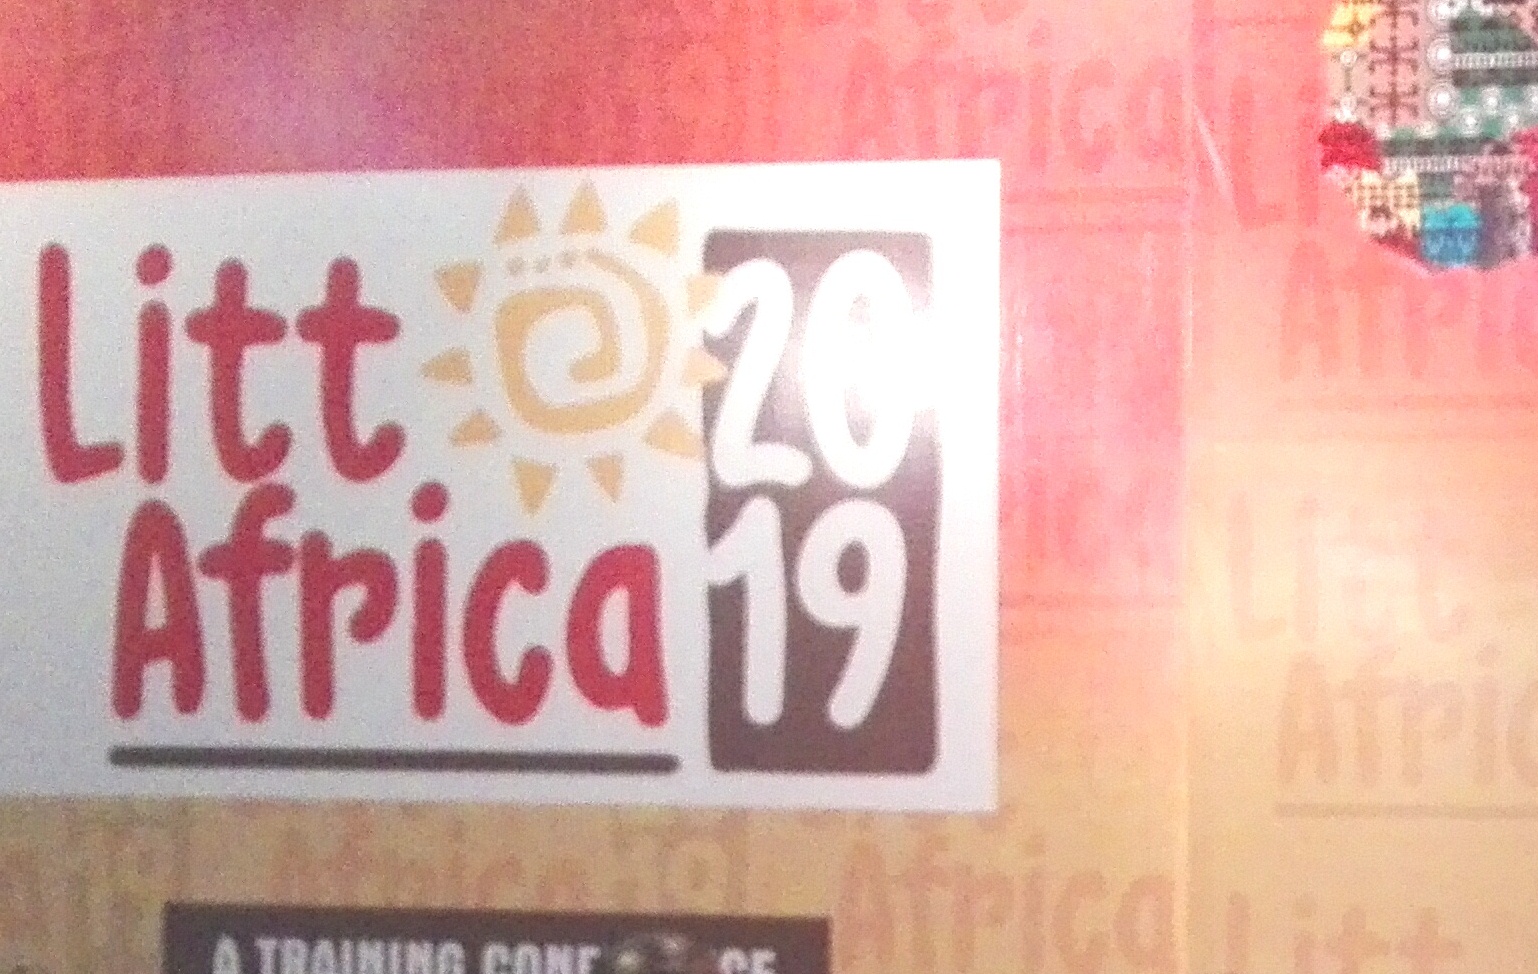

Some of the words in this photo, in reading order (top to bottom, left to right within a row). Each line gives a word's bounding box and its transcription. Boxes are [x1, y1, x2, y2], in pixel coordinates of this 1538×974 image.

[38, 243, 405, 483] Litt
[110, 482, 670, 729] Africa
[706, 496, 908, 731] 19
